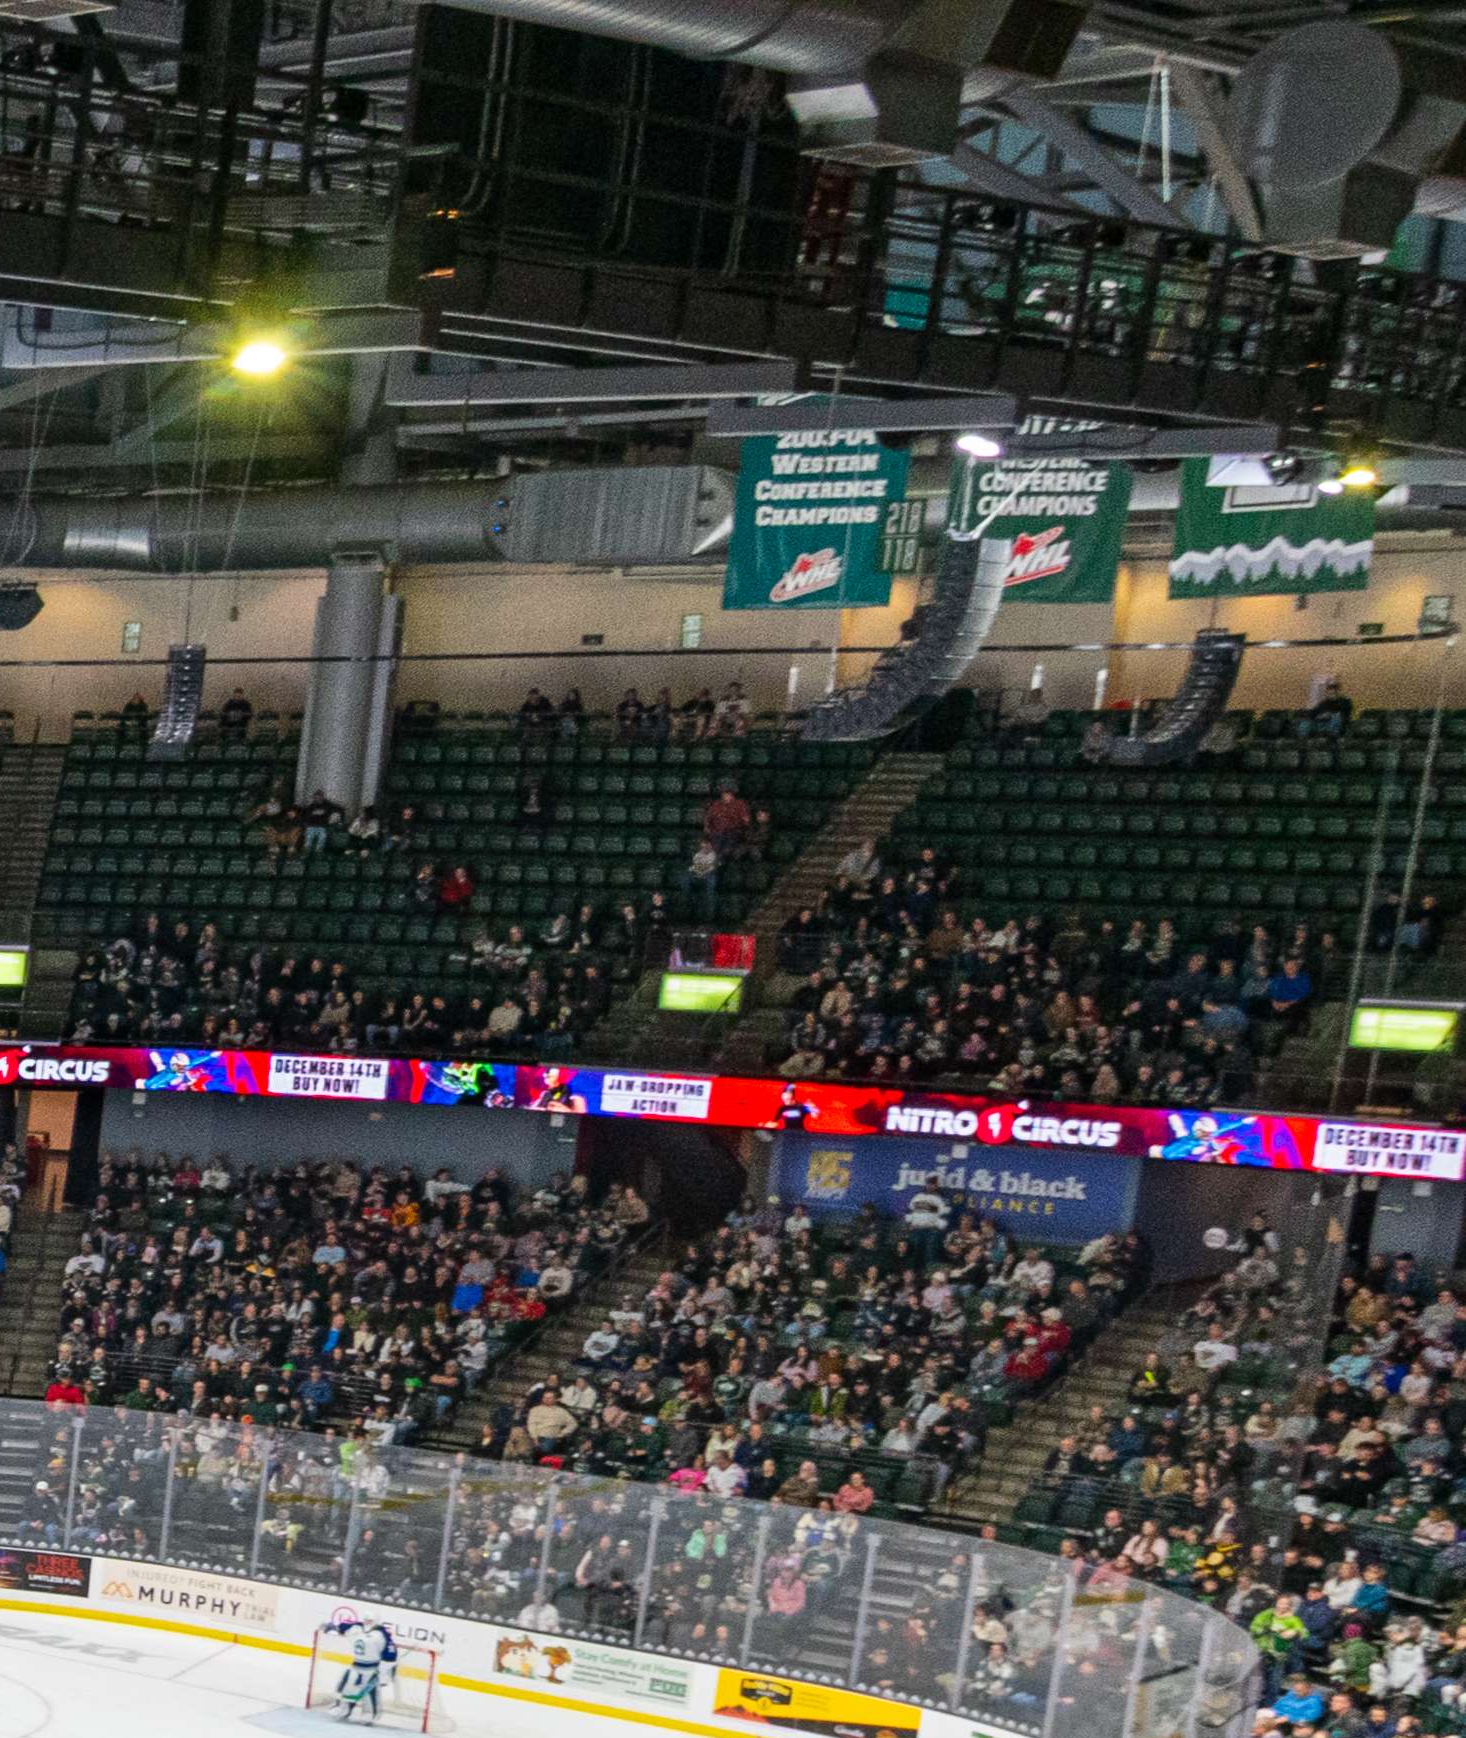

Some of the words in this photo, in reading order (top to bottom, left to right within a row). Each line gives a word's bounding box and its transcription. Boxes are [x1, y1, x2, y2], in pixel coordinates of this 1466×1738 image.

[18, 1057, 109, 1082] CIRCUS
[274, 1059, 345, 1077] DECEMBER
[349, 1061, 383, 1079] 14TH
[292, 1076, 319, 1092] BUY
[323, 1077, 359, 1094] NOW!
[631, 1099, 677, 1114] ACTION
[887, 1108, 978, 1138] NITRO
[1012, 1116, 1121, 1147] CIRCUS
[1324, 1127, 1416, 1151] DECEMBER
[1420, 1132, 1461, 1155] 14TH
[1346, 1149, 1385, 1168] BUY
[1391, 1152, 1431, 1173] NOW!
[970, 1168, 995, 1191] &
[1001, 1170, 1087, 1200] black
[188, 1576, 221, 1591] FIGHT
[227, 1584, 256, 1598] BACK
[139, 1586, 241, 1617] MURPHY
